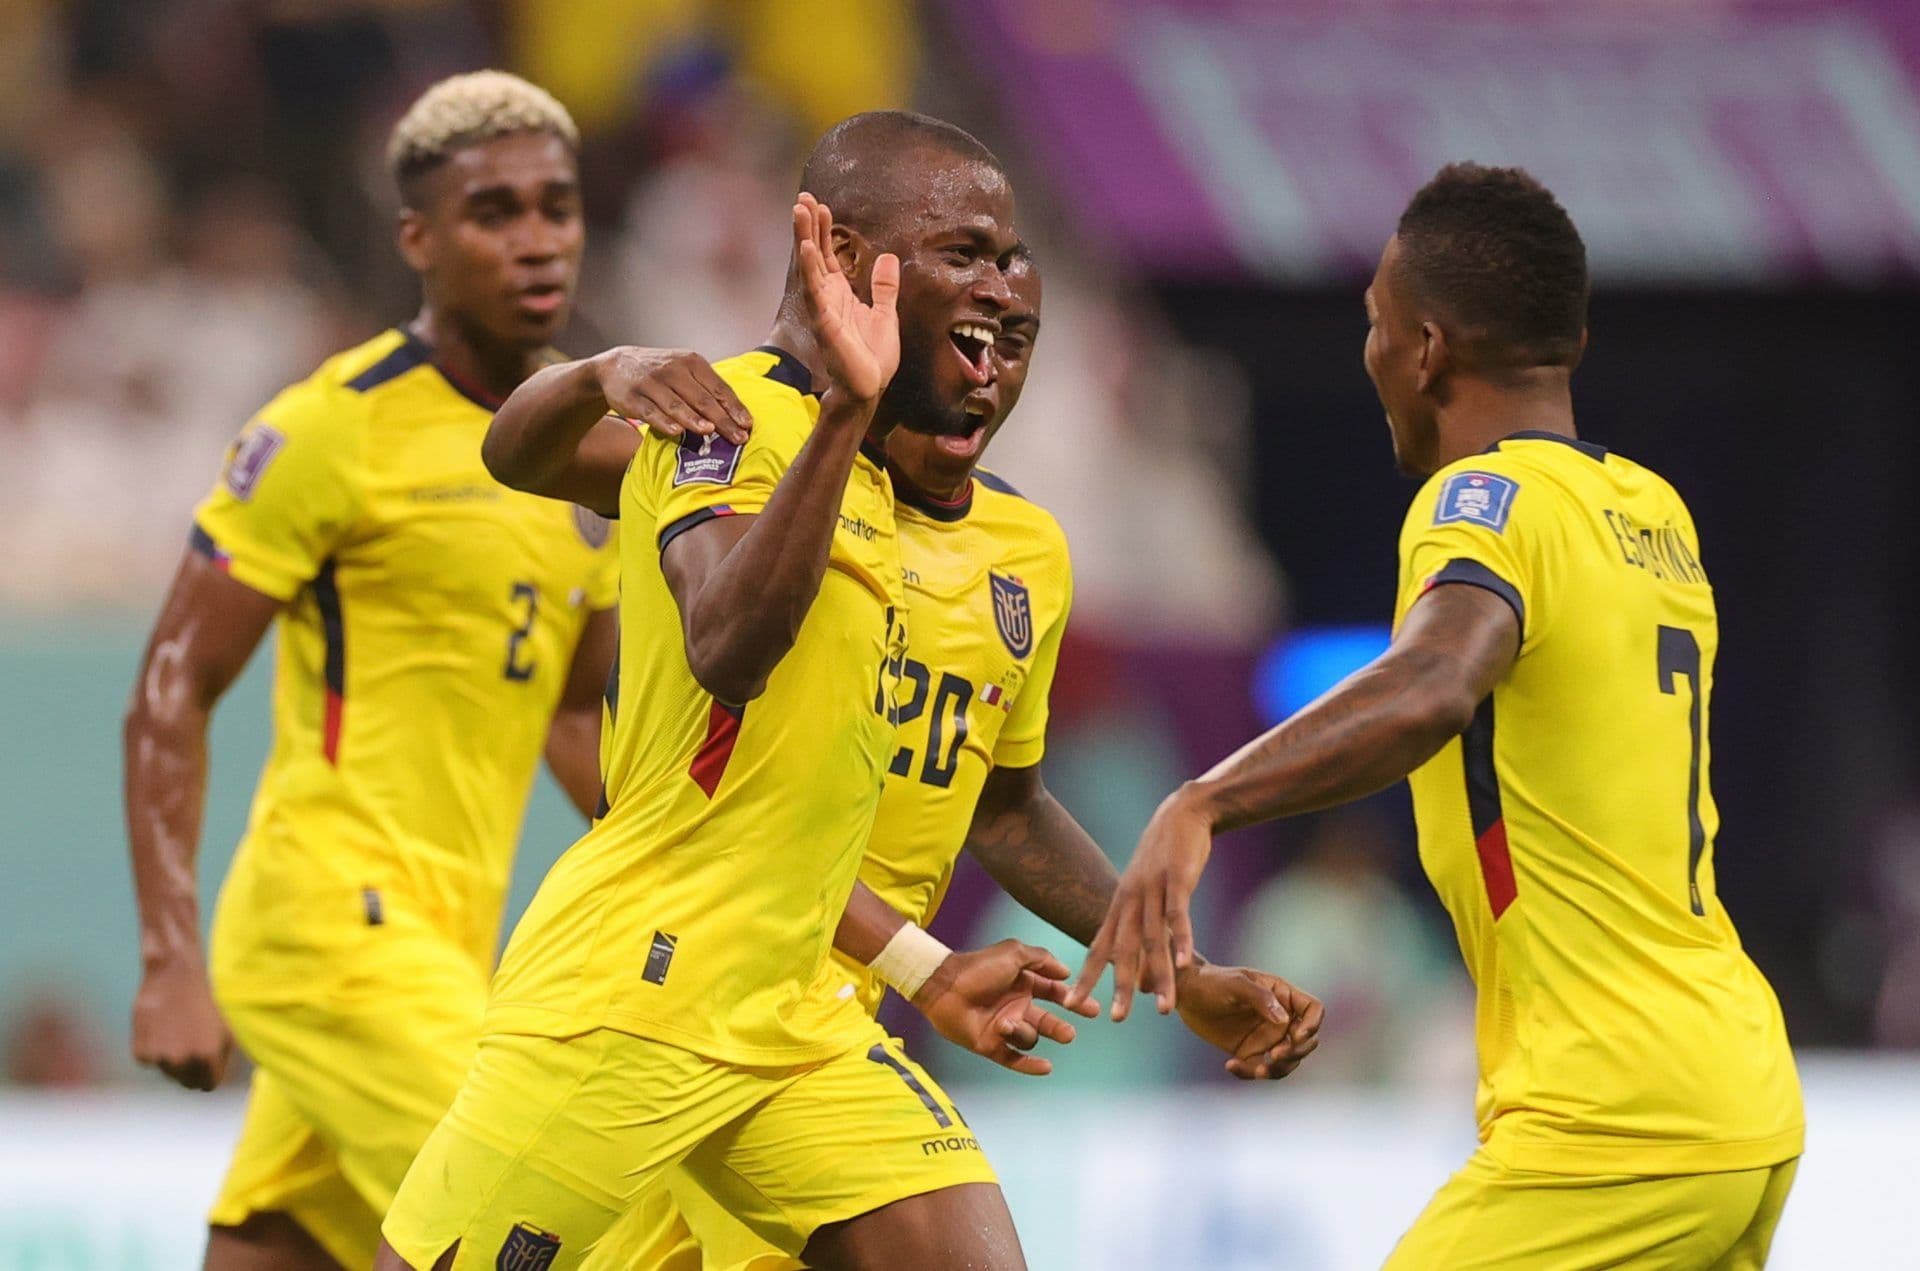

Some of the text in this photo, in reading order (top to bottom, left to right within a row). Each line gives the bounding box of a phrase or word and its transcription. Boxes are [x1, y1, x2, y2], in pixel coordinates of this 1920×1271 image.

[505, 583, 538, 682] 2
[888, 656, 975, 789] 20
[1657, 624, 1706, 917] 7
[921, 1136, 981, 1156] mara
